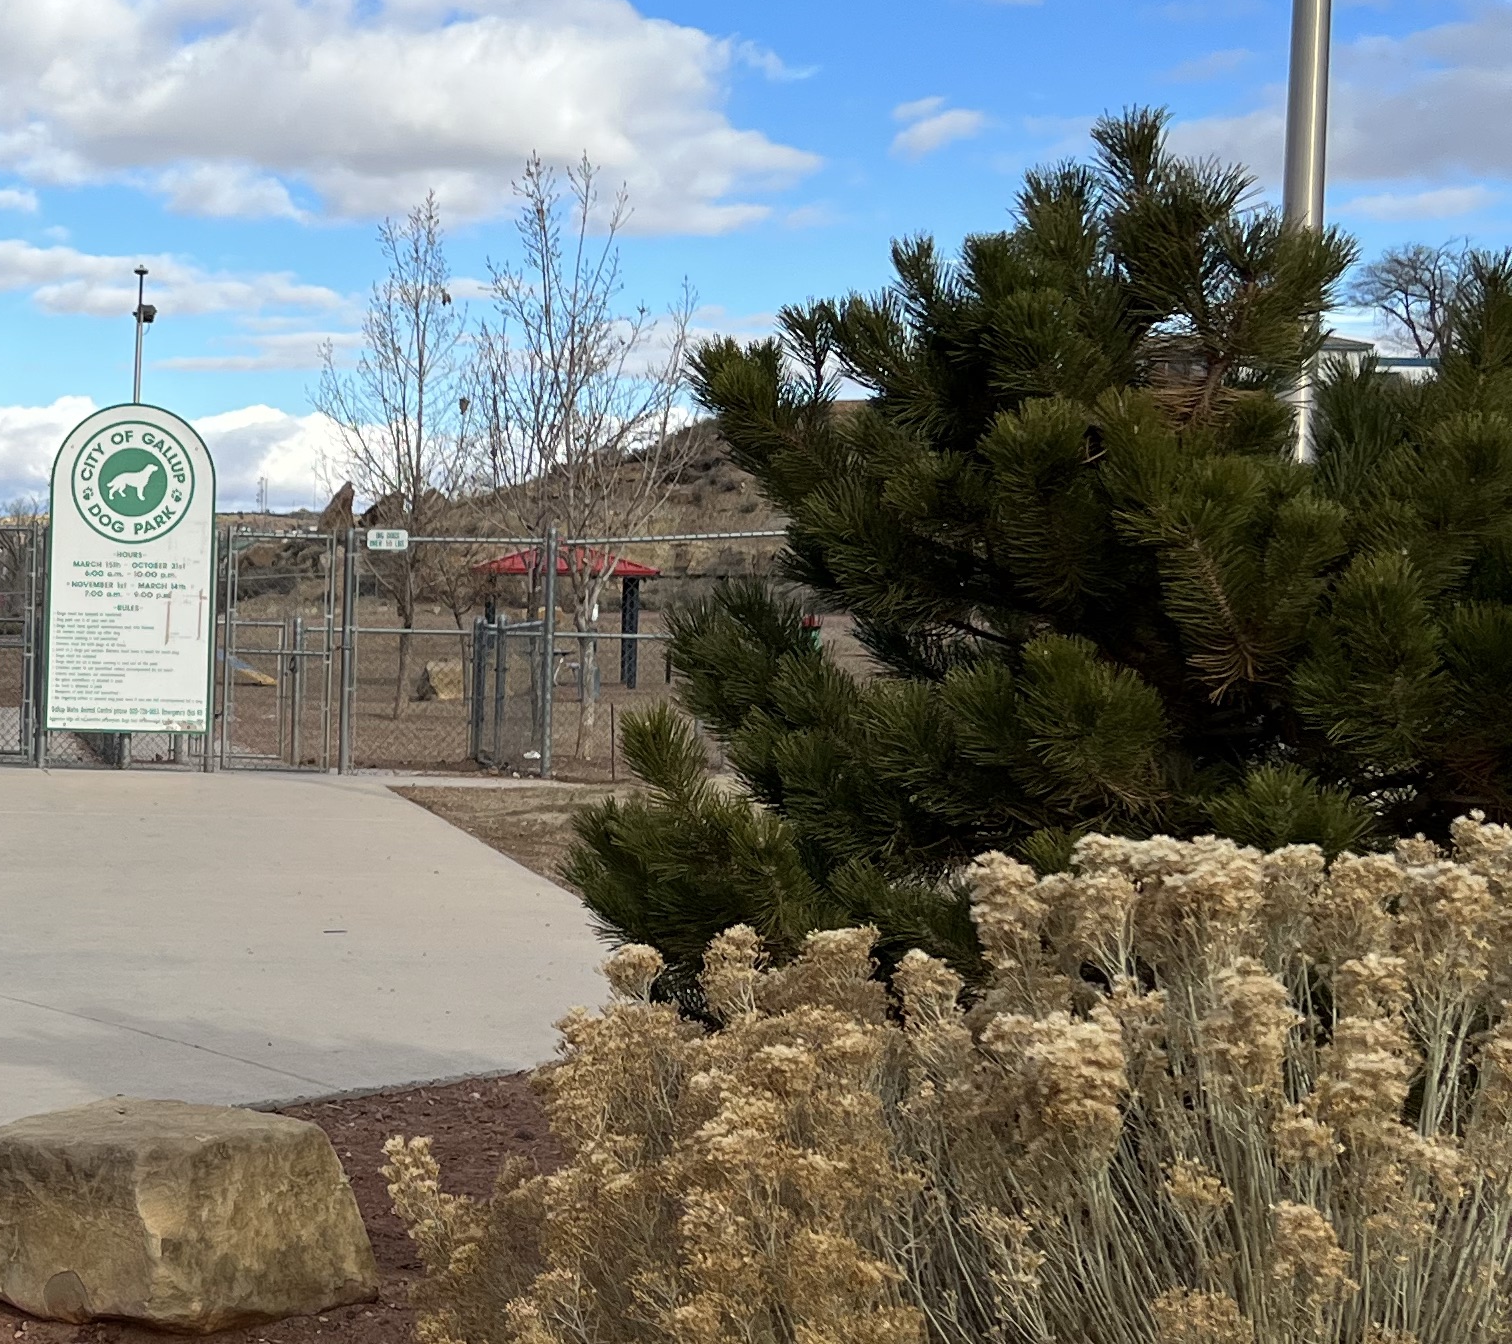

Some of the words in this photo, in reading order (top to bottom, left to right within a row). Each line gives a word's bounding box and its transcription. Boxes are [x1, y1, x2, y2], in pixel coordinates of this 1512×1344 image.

[80, 443, 105, 481] CITY
[110, 430, 134, 445] OF
[141, 432, 186, 484] GALLUP
[88, 503, 124, 533] DOG
[134, 505, 176, 535] PARK
